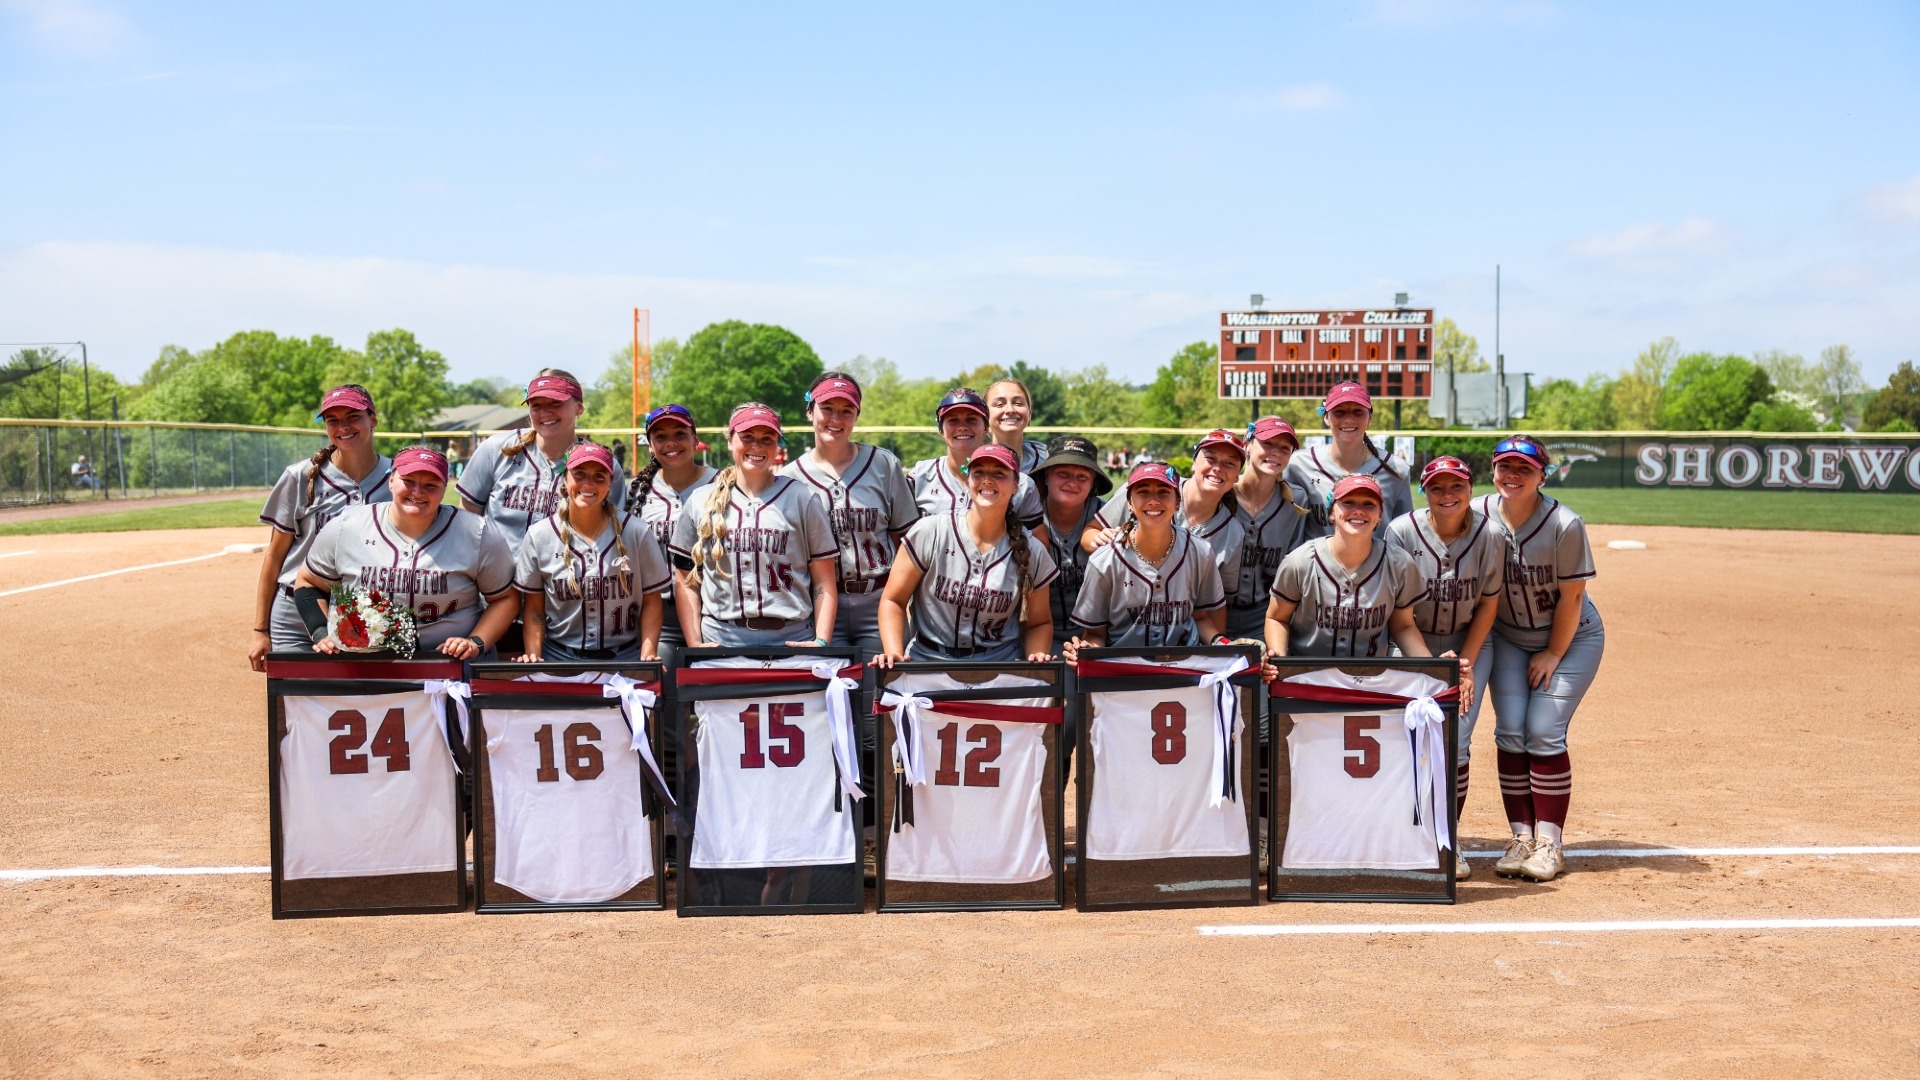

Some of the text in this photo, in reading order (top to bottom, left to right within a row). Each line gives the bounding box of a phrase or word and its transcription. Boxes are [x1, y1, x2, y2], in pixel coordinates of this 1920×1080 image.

[1363, 312, 1427, 324] COLLEGE
[1282, 330, 1303, 343] BALL
[1319, 329, 1351, 343] STRIKE
[1364, 329, 1382, 343] OUT
[1225, 371, 1267, 385] GUESTS
[502, 484, 560, 516] WASHING
[361, 566, 450, 596] WASHINGTON
[766, 560, 794, 593] 15
[934, 574, 1013, 614] WASHINGTON
[611, 602, 640, 637] 16
[327, 708, 410, 775] 24
[738, 702, 805, 769] 15
[1150, 701, 1187, 765] 8
[1343, 715, 1381, 779] 5
[533, 721, 604, 783] 16
[934, 721, 1002, 787] 12
